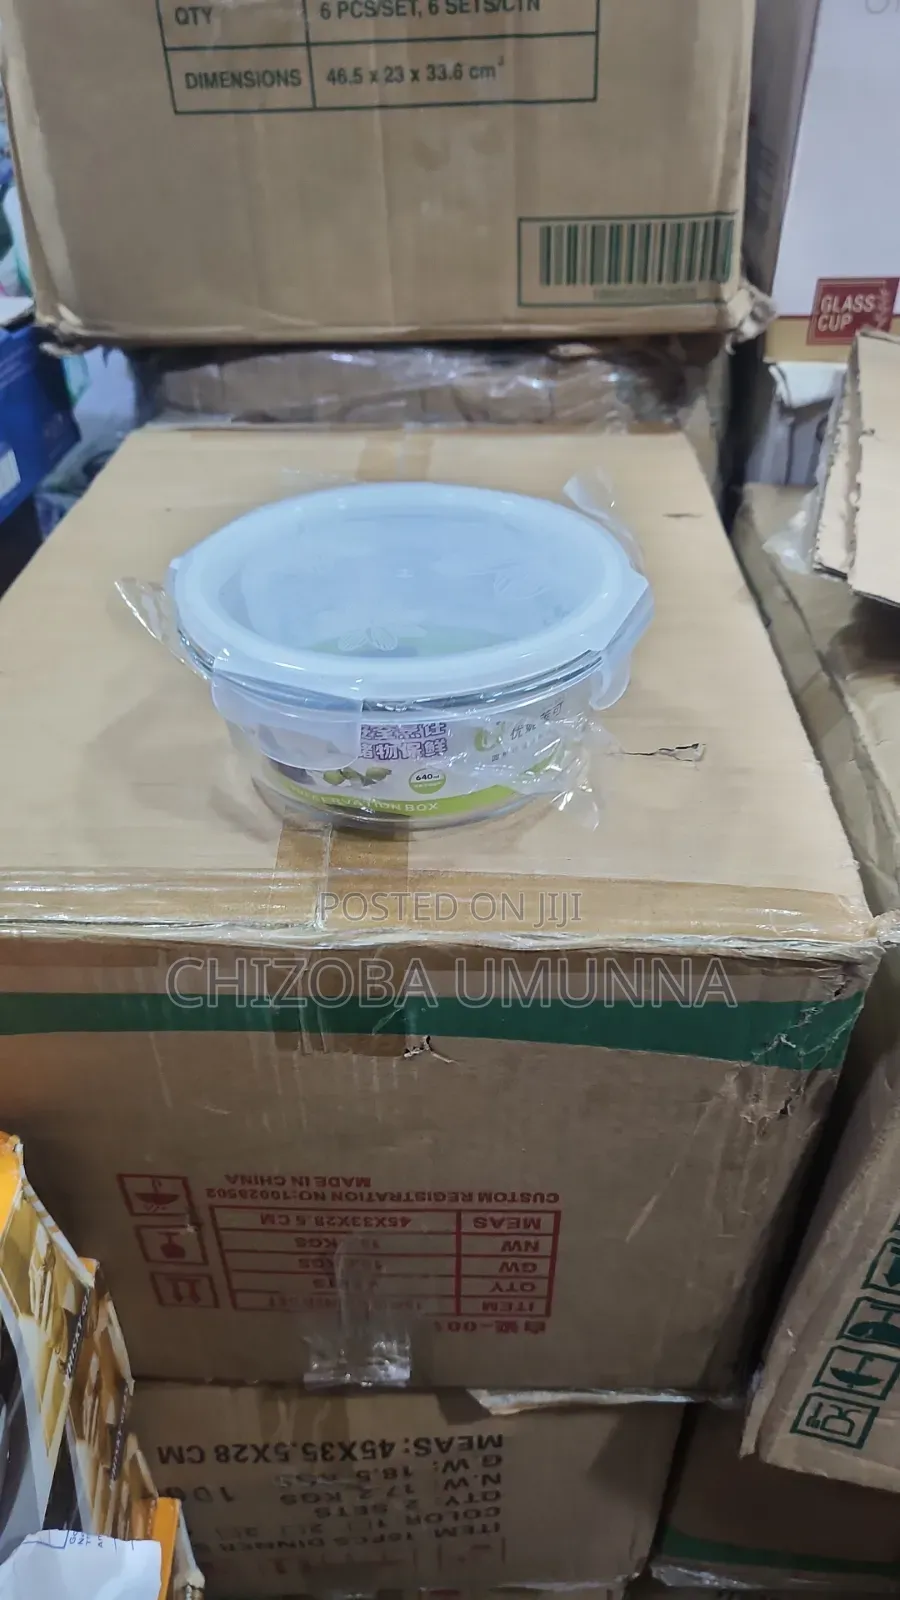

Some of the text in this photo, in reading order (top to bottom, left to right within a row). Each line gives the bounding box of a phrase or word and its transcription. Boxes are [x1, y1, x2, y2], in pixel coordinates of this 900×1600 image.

[174, 7, 214, 26] QTY
[320, 0, 332, 20] 6
[185, 69, 302, 91] DIMENSIONS
[325, 67, 364, 86] 46.5
[369, 69, 379, 84] x
[384, 66, 405, 84] 23
[410, 67, 420, 83] x
[426, 62, 465, 82] 33.6
[820, 293, 876, 313] GLASS
[817, 313, 853, 332] CUP
[404, 802, 439, 812] BOX
[223, 1174, 372, 1188] MADE IN CHINA
[331, 1190, 474, 1203] REGISTRATION
[477, 1192, 560, 1203] CUSTOM
[260, 1213, 291, 1226] CM
[472, 1217, 542, 1230] MEAS
[500, 1240, 540, 1252] NW
[498, 1261, 538, 1273] GW
[489, 1281, 537, 1293] QTY
[481, 1301, 535, 1313] ITEM
[404, 1434, 504, 1457] MEAS:
[157, 1445, 206, 1465] CM
[433, 1522, 501, 1539] ITEM
